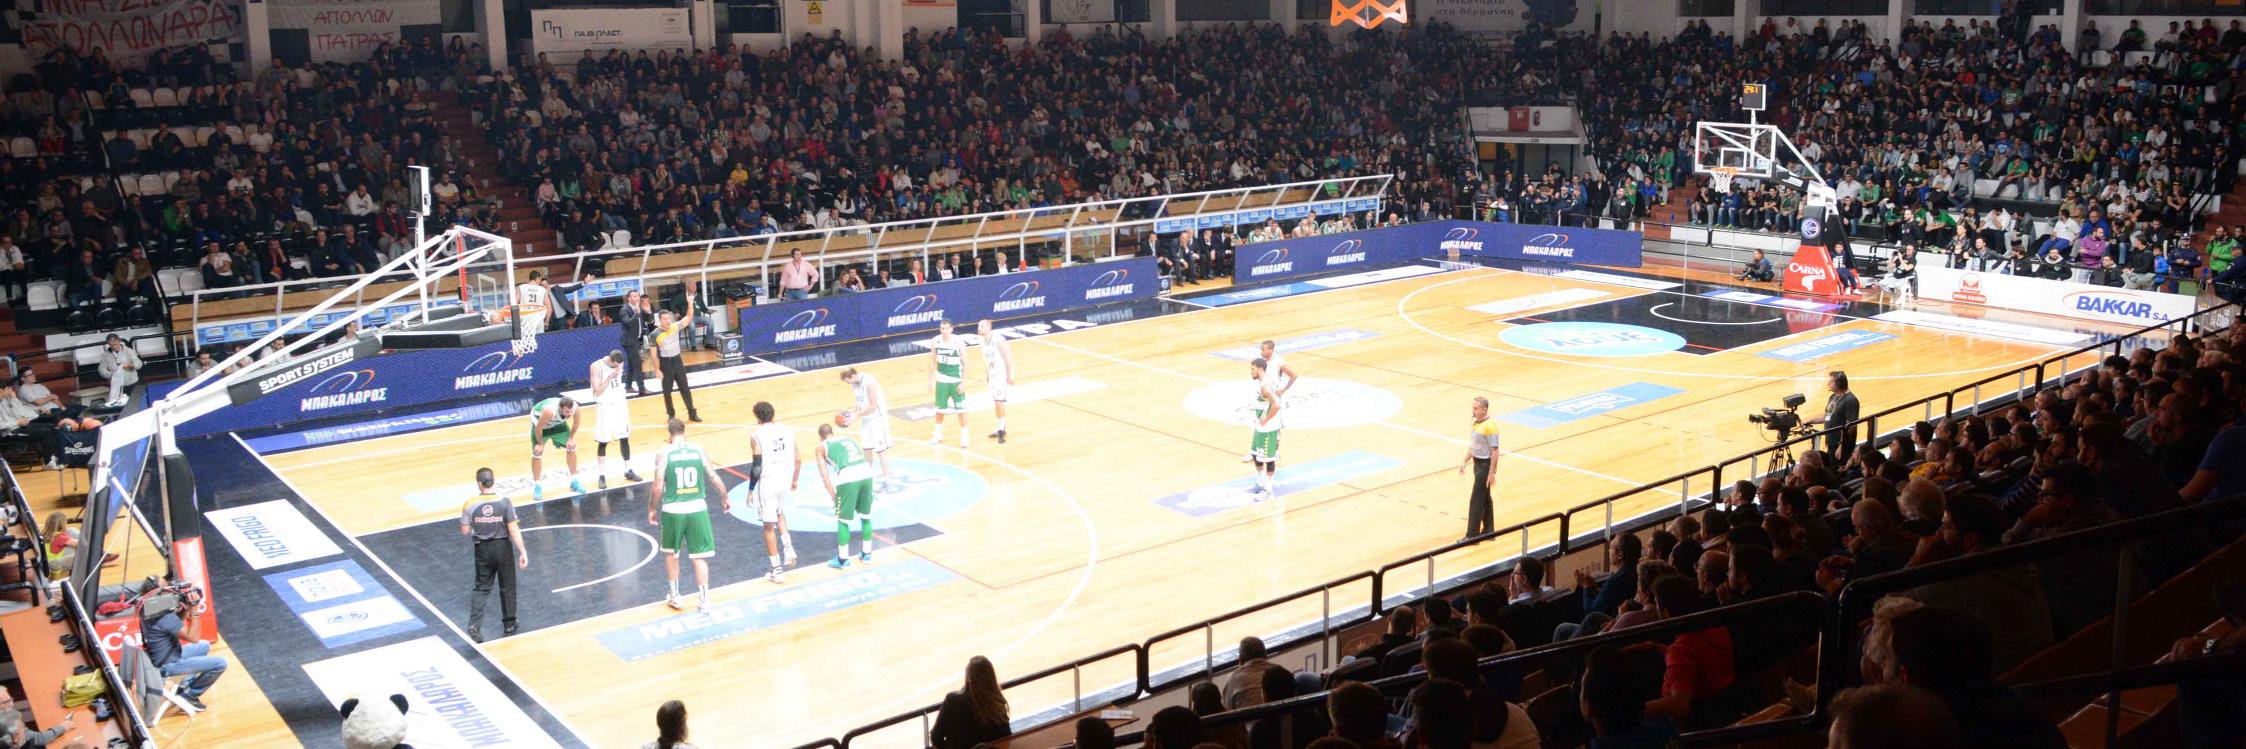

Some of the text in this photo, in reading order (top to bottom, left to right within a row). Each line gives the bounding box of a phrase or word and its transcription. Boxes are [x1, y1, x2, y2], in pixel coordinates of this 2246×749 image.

[314, 9, 394, 25] ΑΠΟΛΛΩΝ
[316, 31, 395, 50] ΠΑΤΡΑΣ
[1789, 262, 1826, 279] CARNA
[528, 293, 537, 303] 21
[2076, 295, 2152, 319] BAKKAR
[775, 324, 837, 343] ΜΠΑΚΑΛΑΡΟΣ
[259, 347, 354, 391] SPORT SYSTEM
[455, 367, 534, 389] ΜΠΑΚΑΛΑΡΟΣ
[301, 387, 388, 411] ΜΠΑΚΑΛΑΡΟΣ
[674, 466, 698, 489] 10
[638, 603, 745, 642] MED
